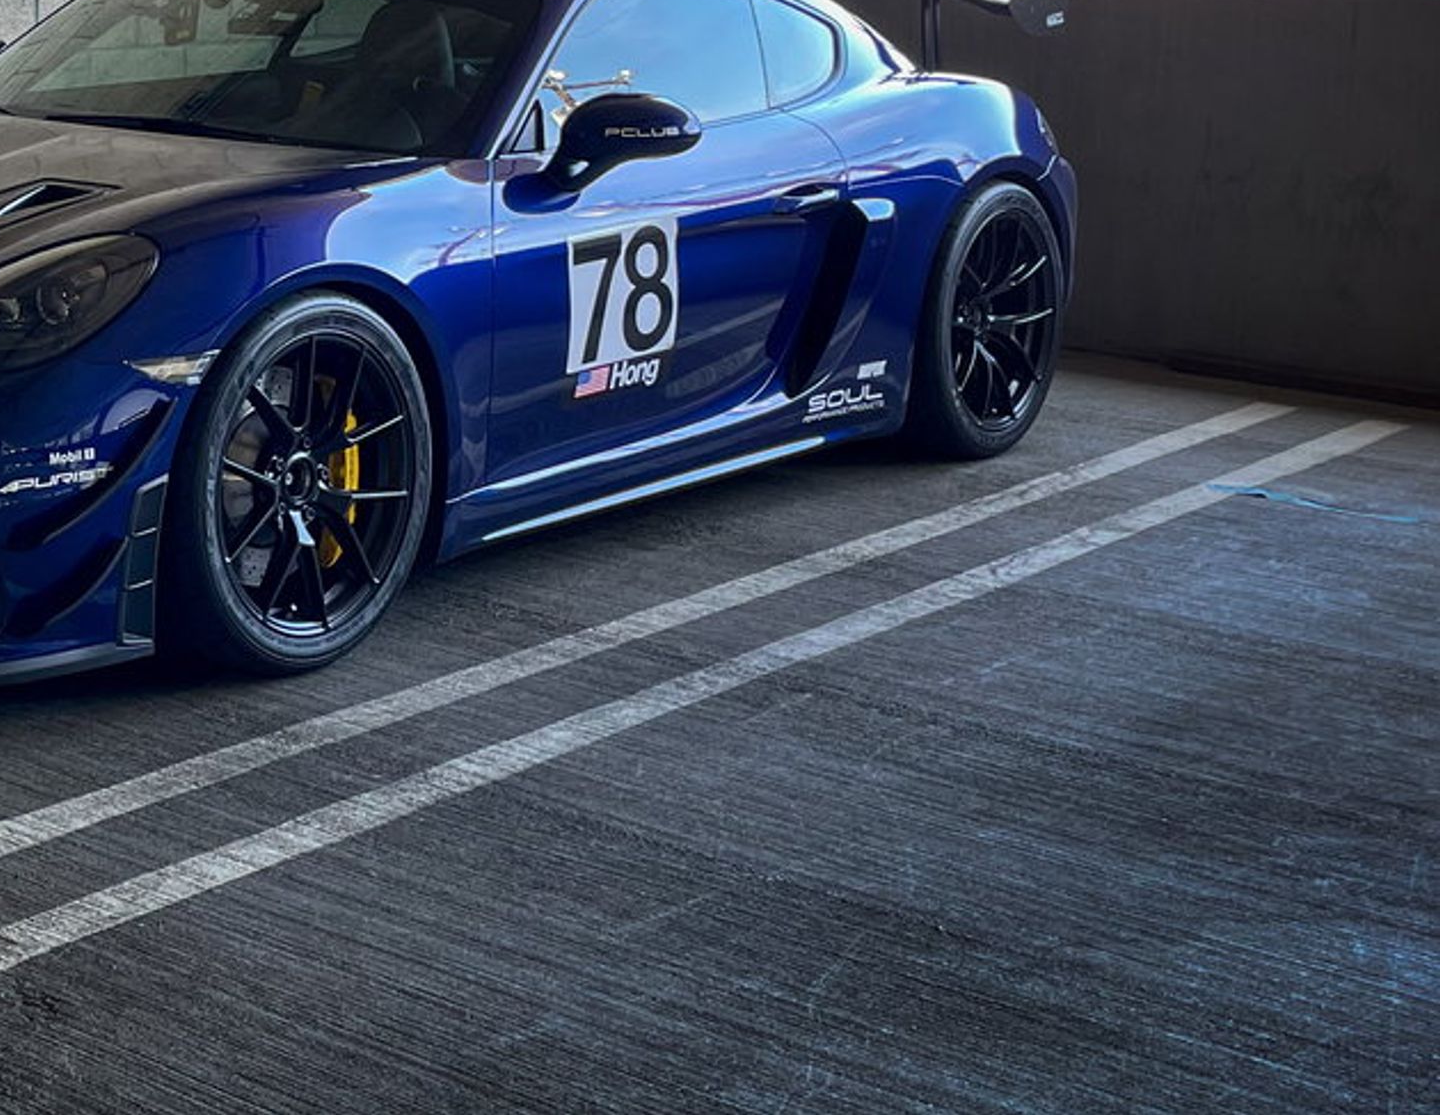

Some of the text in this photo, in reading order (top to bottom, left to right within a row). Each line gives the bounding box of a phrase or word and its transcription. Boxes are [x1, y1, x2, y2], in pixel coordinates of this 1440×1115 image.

[605, 127, 680, 138] PCLUB
[573, 225, 674, 364] 78
[610, 358, 661, 390] Hong
[808, 383, 883, 413] SOUL
[49, 450, 82, 466] Mobil
